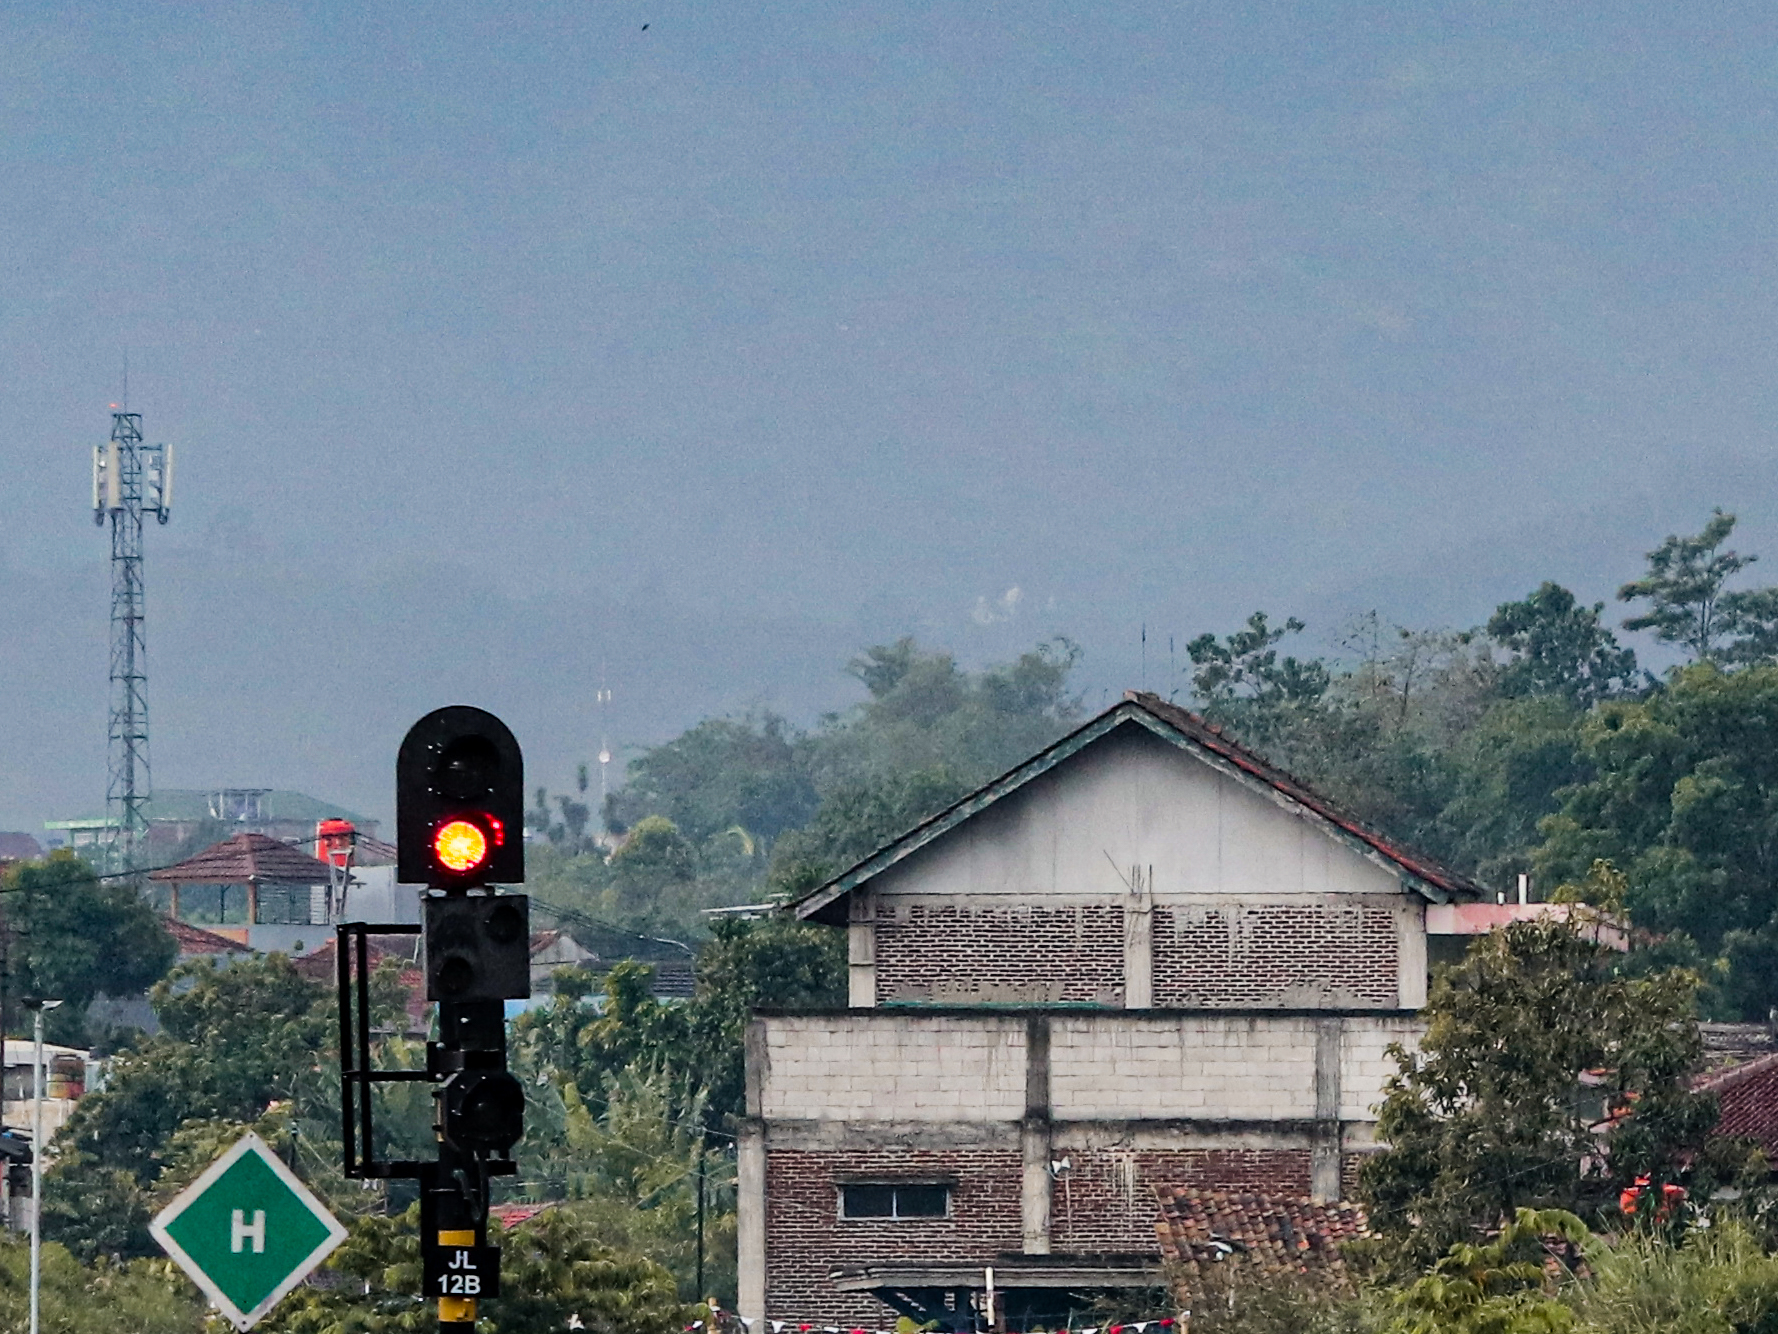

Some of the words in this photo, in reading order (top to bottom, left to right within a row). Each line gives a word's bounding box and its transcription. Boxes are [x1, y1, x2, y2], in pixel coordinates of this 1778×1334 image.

[231, 1208, 266, 1253] H
[448, 1250, 477, 1270] JL
[437, 1273, 481, 1295] 12B
